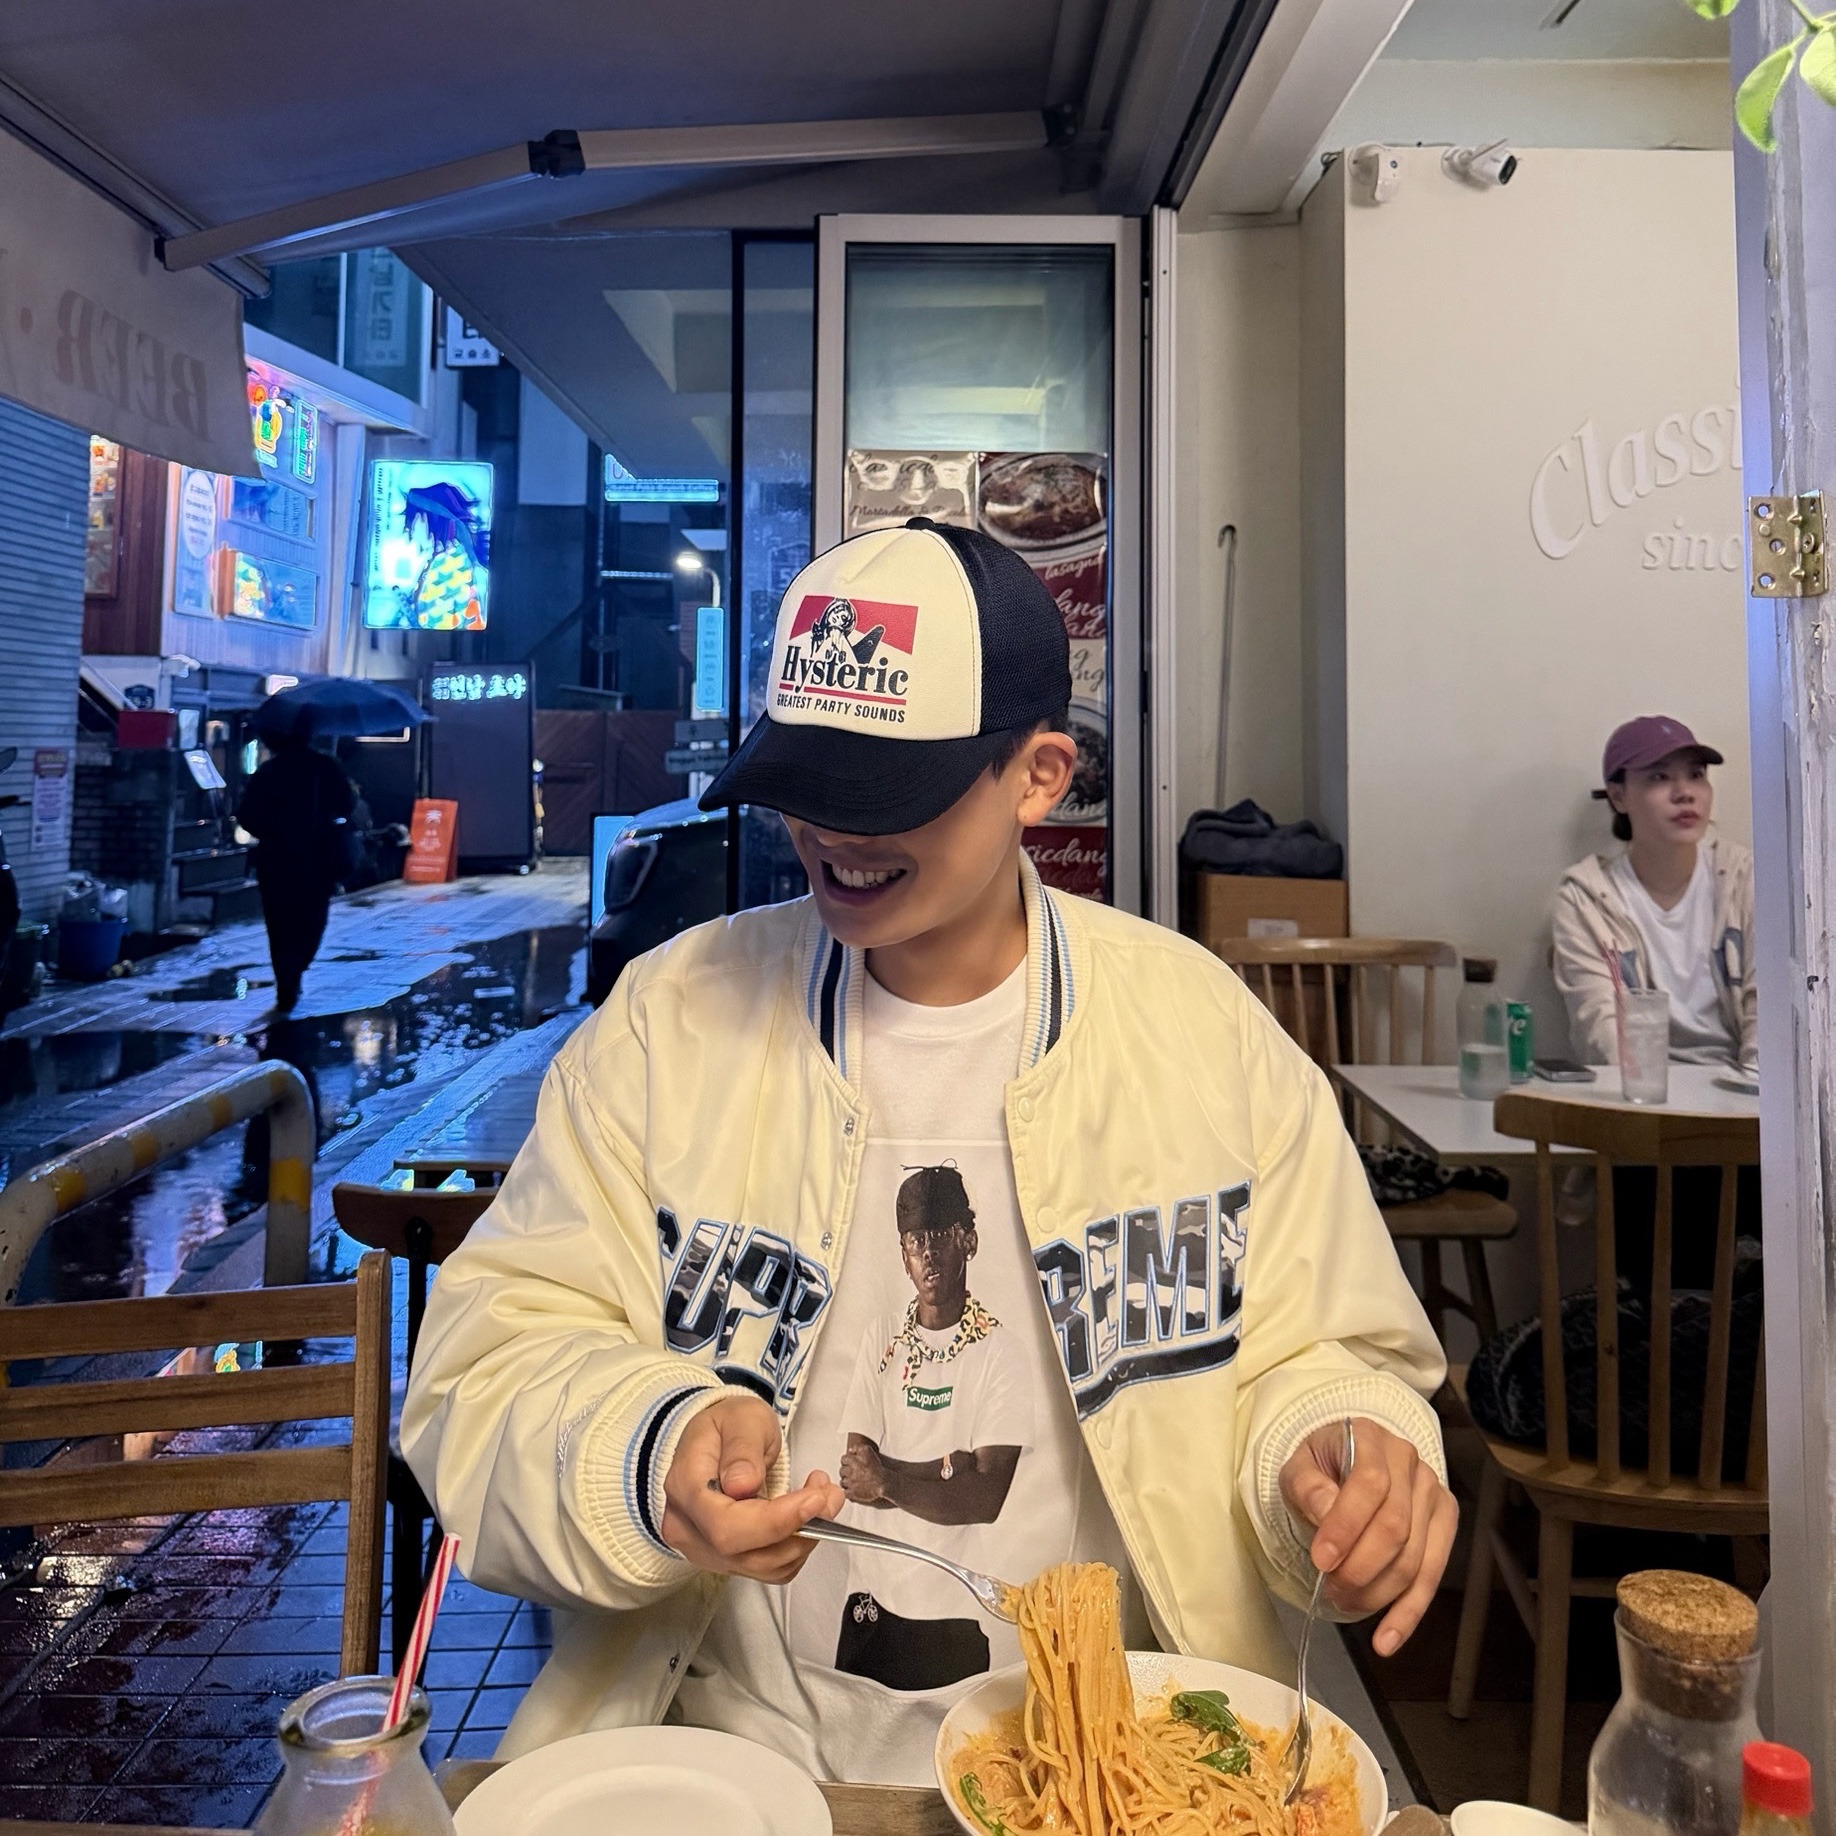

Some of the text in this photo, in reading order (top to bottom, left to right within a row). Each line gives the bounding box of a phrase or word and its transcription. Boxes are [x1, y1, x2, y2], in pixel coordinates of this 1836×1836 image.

[781, 645, 909, 696] Hysteric
[776, 693, 906, 724] GREATEST PARTY SOUNDS
[908, 1387, 952, 1407] Supreme
